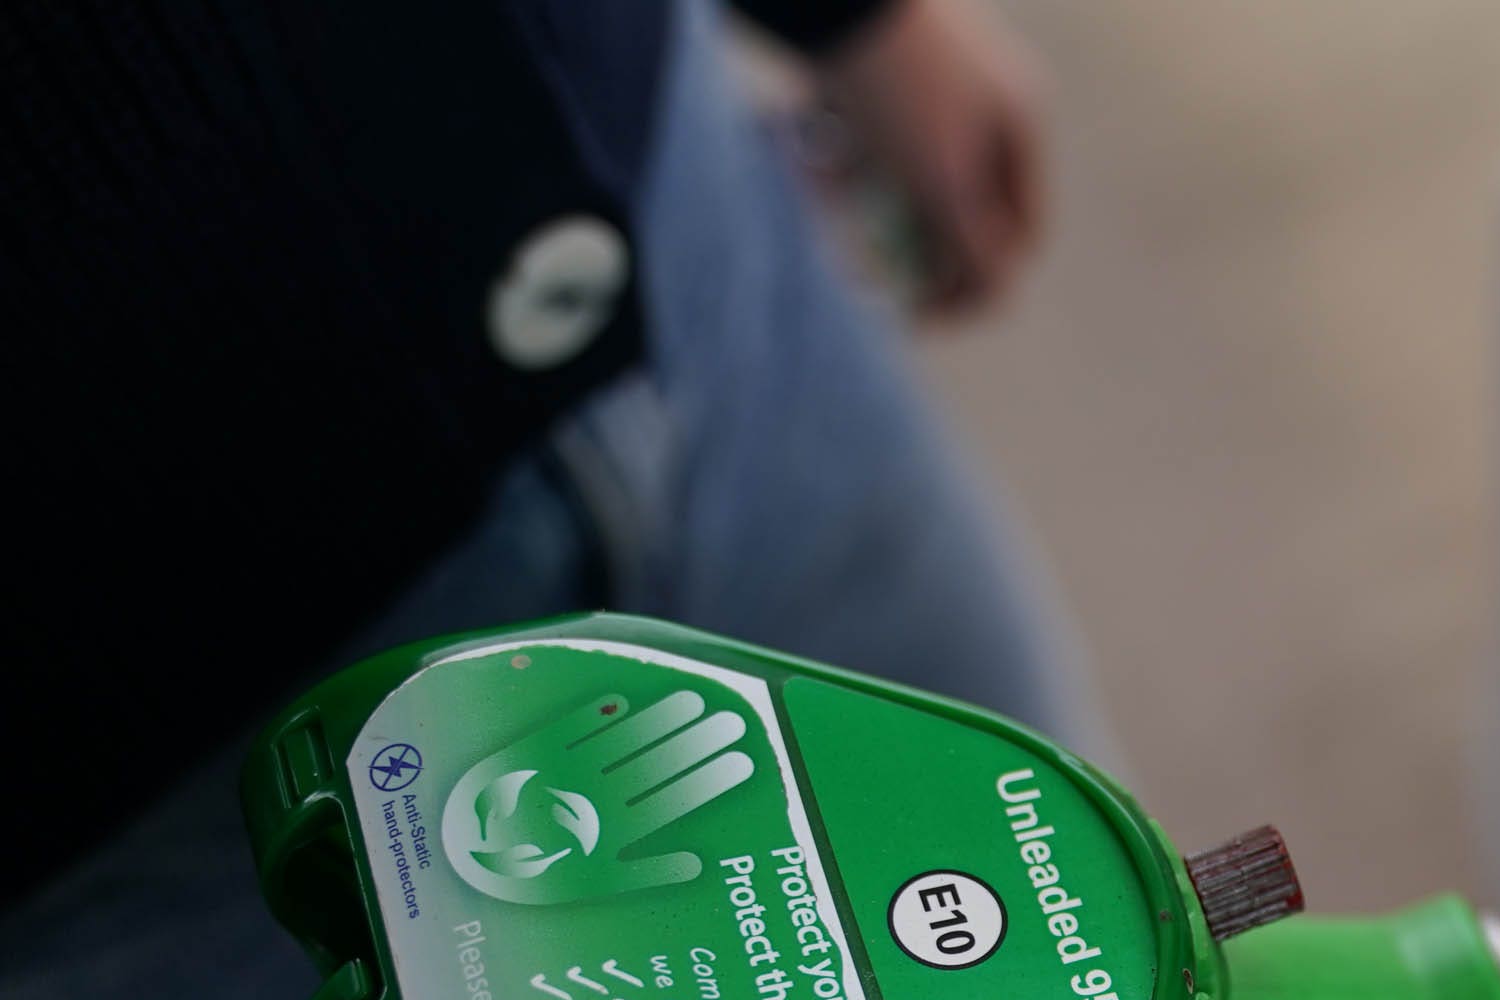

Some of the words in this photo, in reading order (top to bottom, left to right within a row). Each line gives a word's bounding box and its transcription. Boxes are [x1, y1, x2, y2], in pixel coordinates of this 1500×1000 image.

[381, 800, 420, 919] hand-protectors
[401, 794, 430, 870] Anti-Static
[995, 768, 1102, 965] Unleaded
[719, 855, 781, 967] Protect
[771, 845, 832, 957] Protect
[917, 883, 976, 955] E10
[649, 955, 674, 989] we
